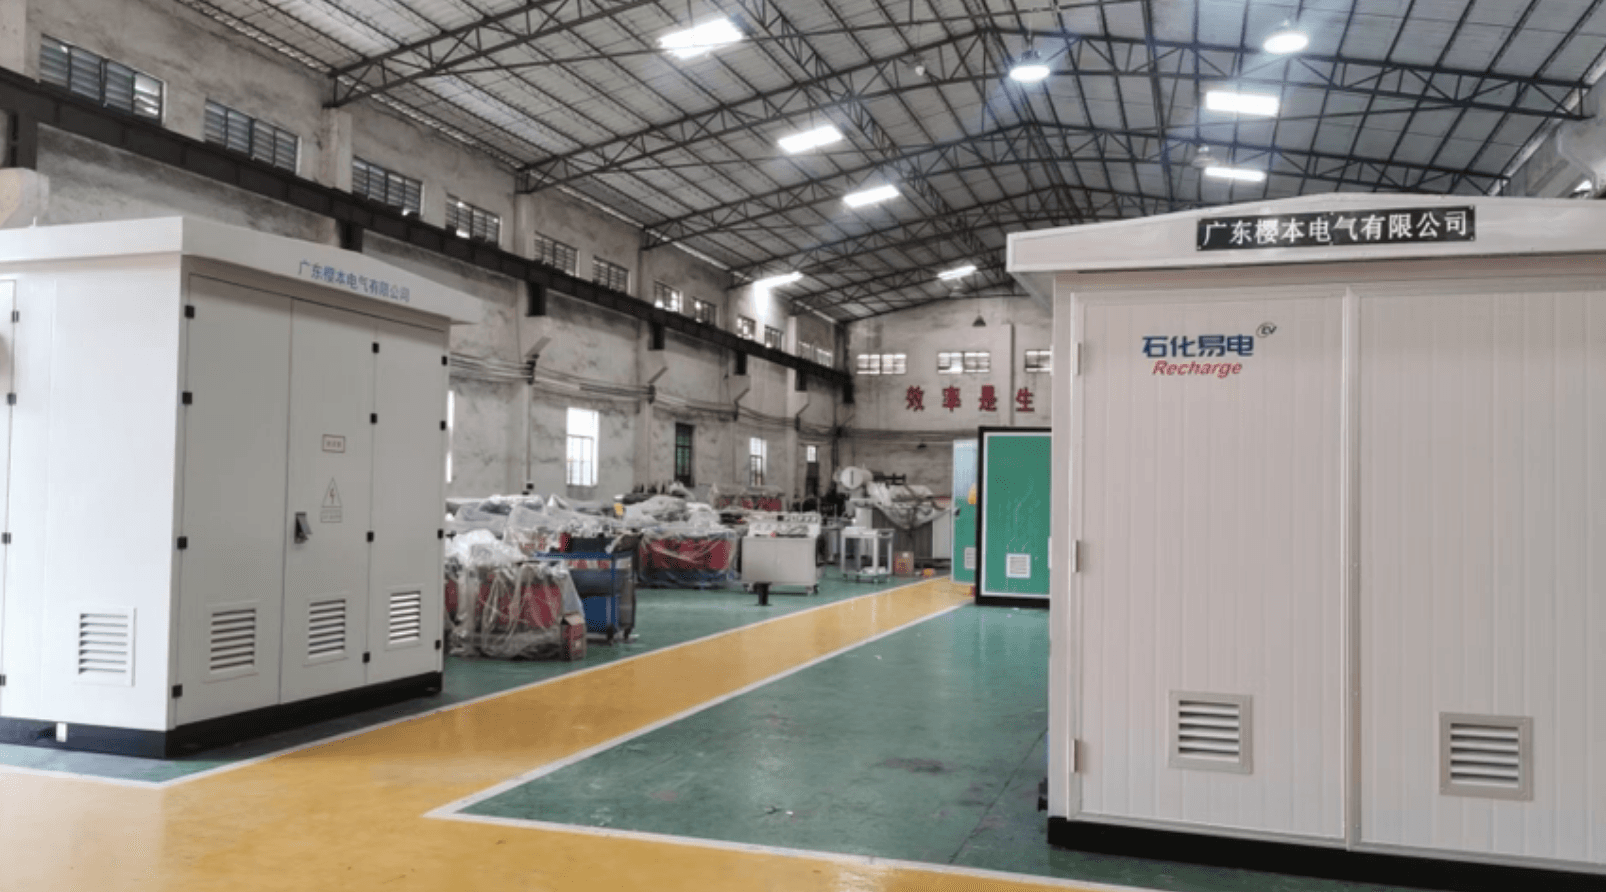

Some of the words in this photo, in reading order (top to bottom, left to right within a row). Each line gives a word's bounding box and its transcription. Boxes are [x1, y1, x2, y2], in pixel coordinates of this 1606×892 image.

[1202, 210, 1468, 246] 广东樱本电气有限公司
[298, 259, 410, 303] 广东樱本电气有限公司
[1142, 333, 1254, 358] 石化易电
[1152, 360, 1242, 379] Recharge
